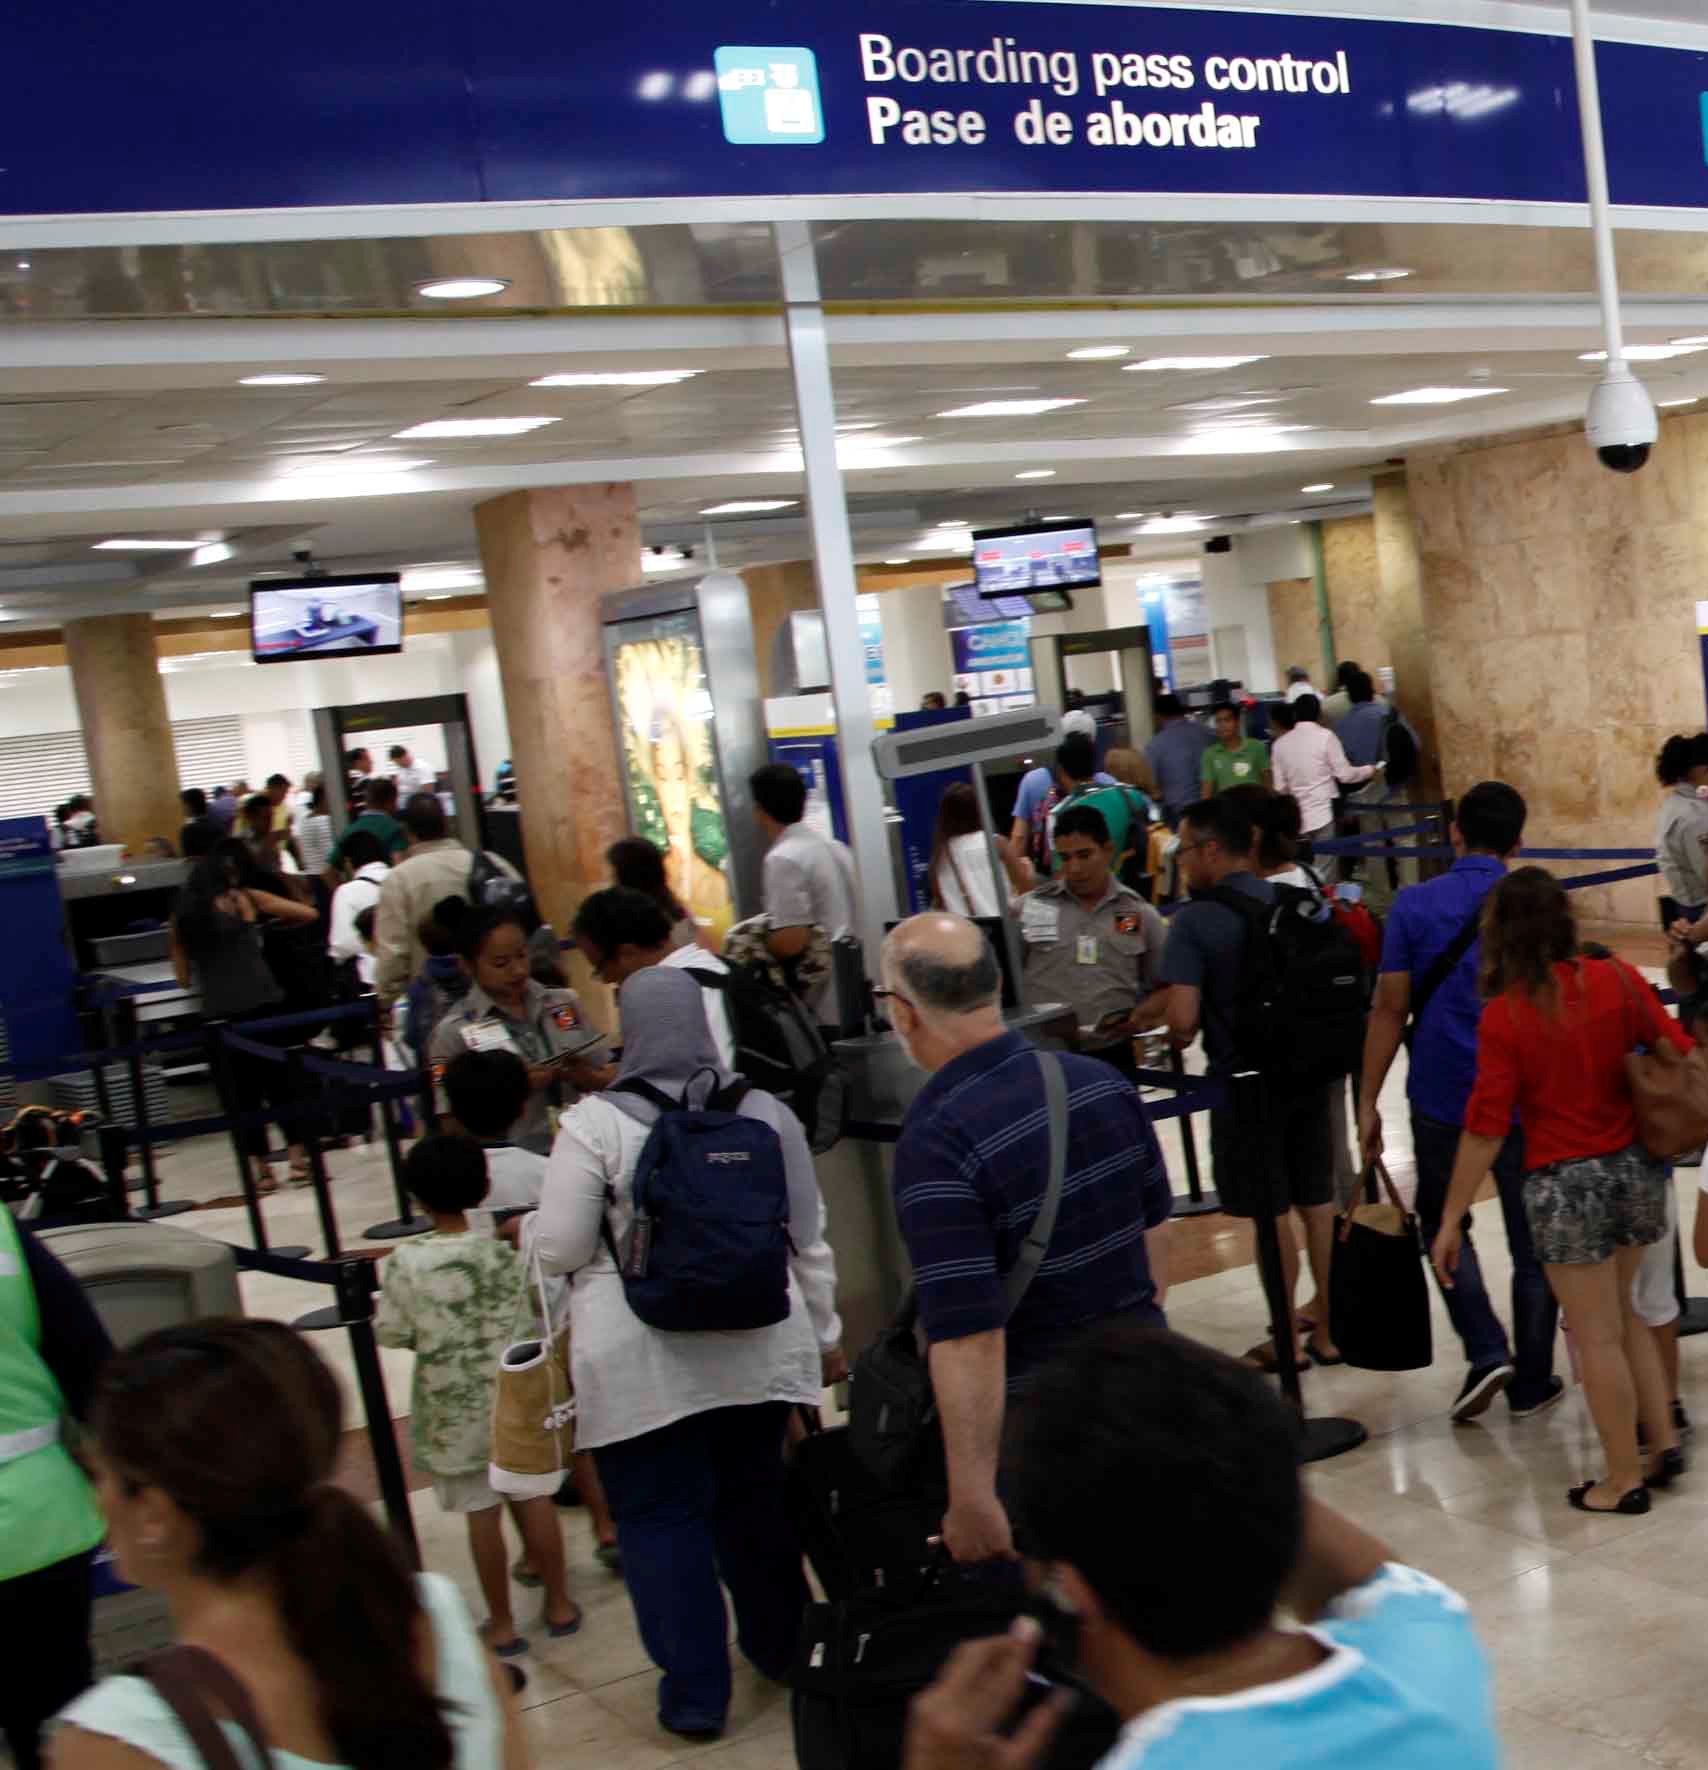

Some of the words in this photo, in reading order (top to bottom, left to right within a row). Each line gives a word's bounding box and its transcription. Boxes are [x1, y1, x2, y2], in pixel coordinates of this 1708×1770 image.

[859, 33, 1080, 97] Boarding
[1091, 52, 1195, 96] pass
[1205, 50, 1350, 94] control
[866, 96, 986, 145] Pase
[1013, 99, 1074, 145] de
[1086, 100, 1261, 148] abordar
